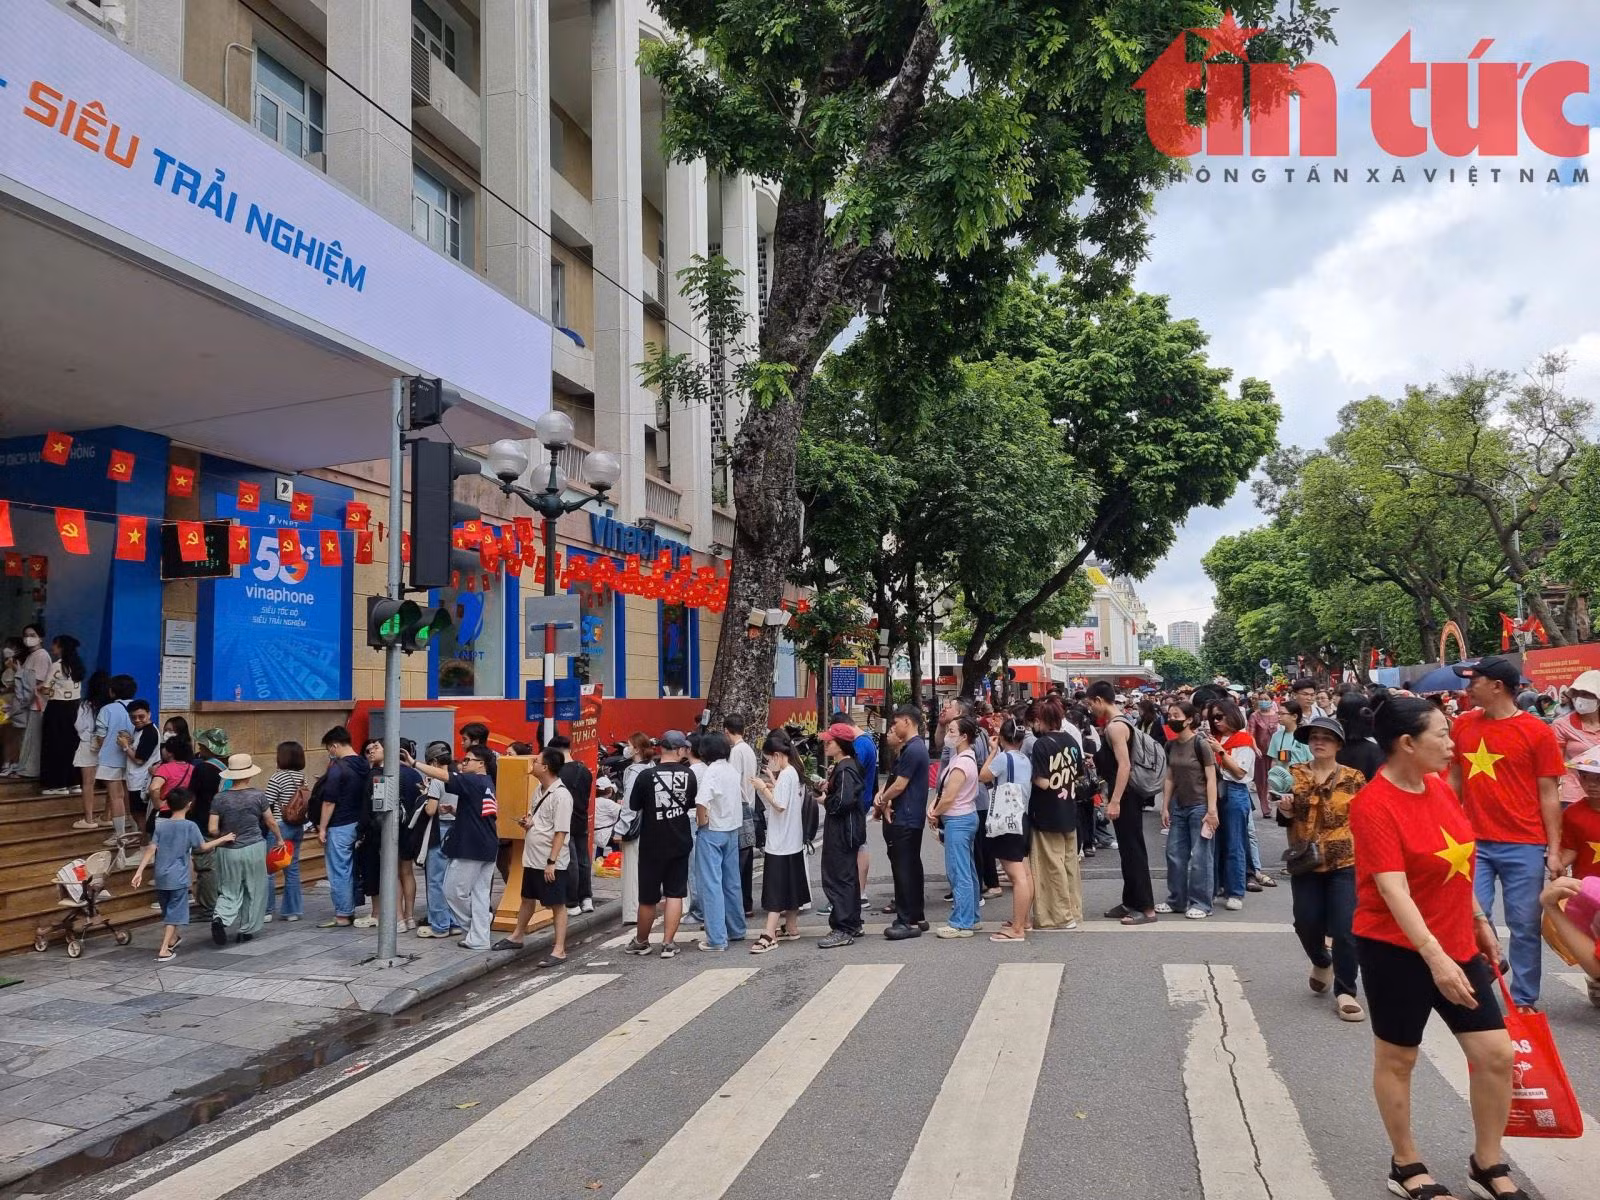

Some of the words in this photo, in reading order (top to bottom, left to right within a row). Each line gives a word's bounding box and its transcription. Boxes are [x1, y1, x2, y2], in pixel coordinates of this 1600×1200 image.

[23, 80, 140, 169] SIÊU
[152, 148, 238, 224] TRẢI
[245, 203, 367, 293] NGHIỆM
[245, 583, 315, 605] vinaphone
